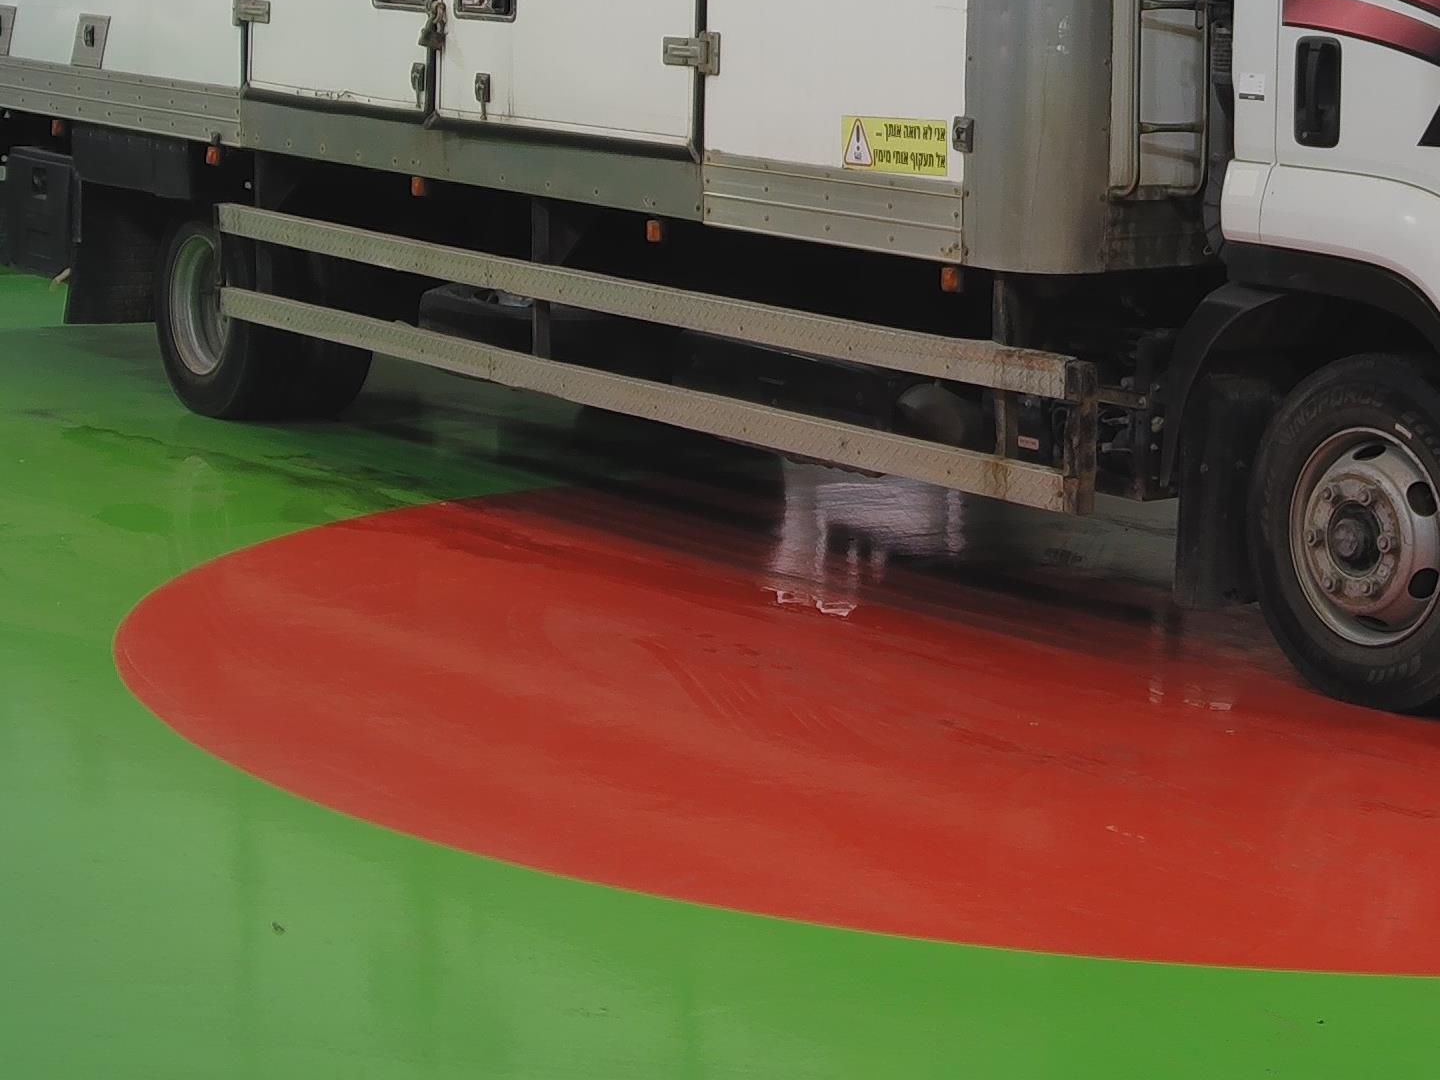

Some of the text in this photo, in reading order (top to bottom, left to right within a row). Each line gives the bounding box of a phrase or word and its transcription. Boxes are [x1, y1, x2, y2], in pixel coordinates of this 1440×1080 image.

[904, 124, 920, 140] רואה
[923, 124, 932, 140] לא
[934, 127, 945, 141] אני
[873, 148, 945, 171] אל תעקוף אותי מימין
